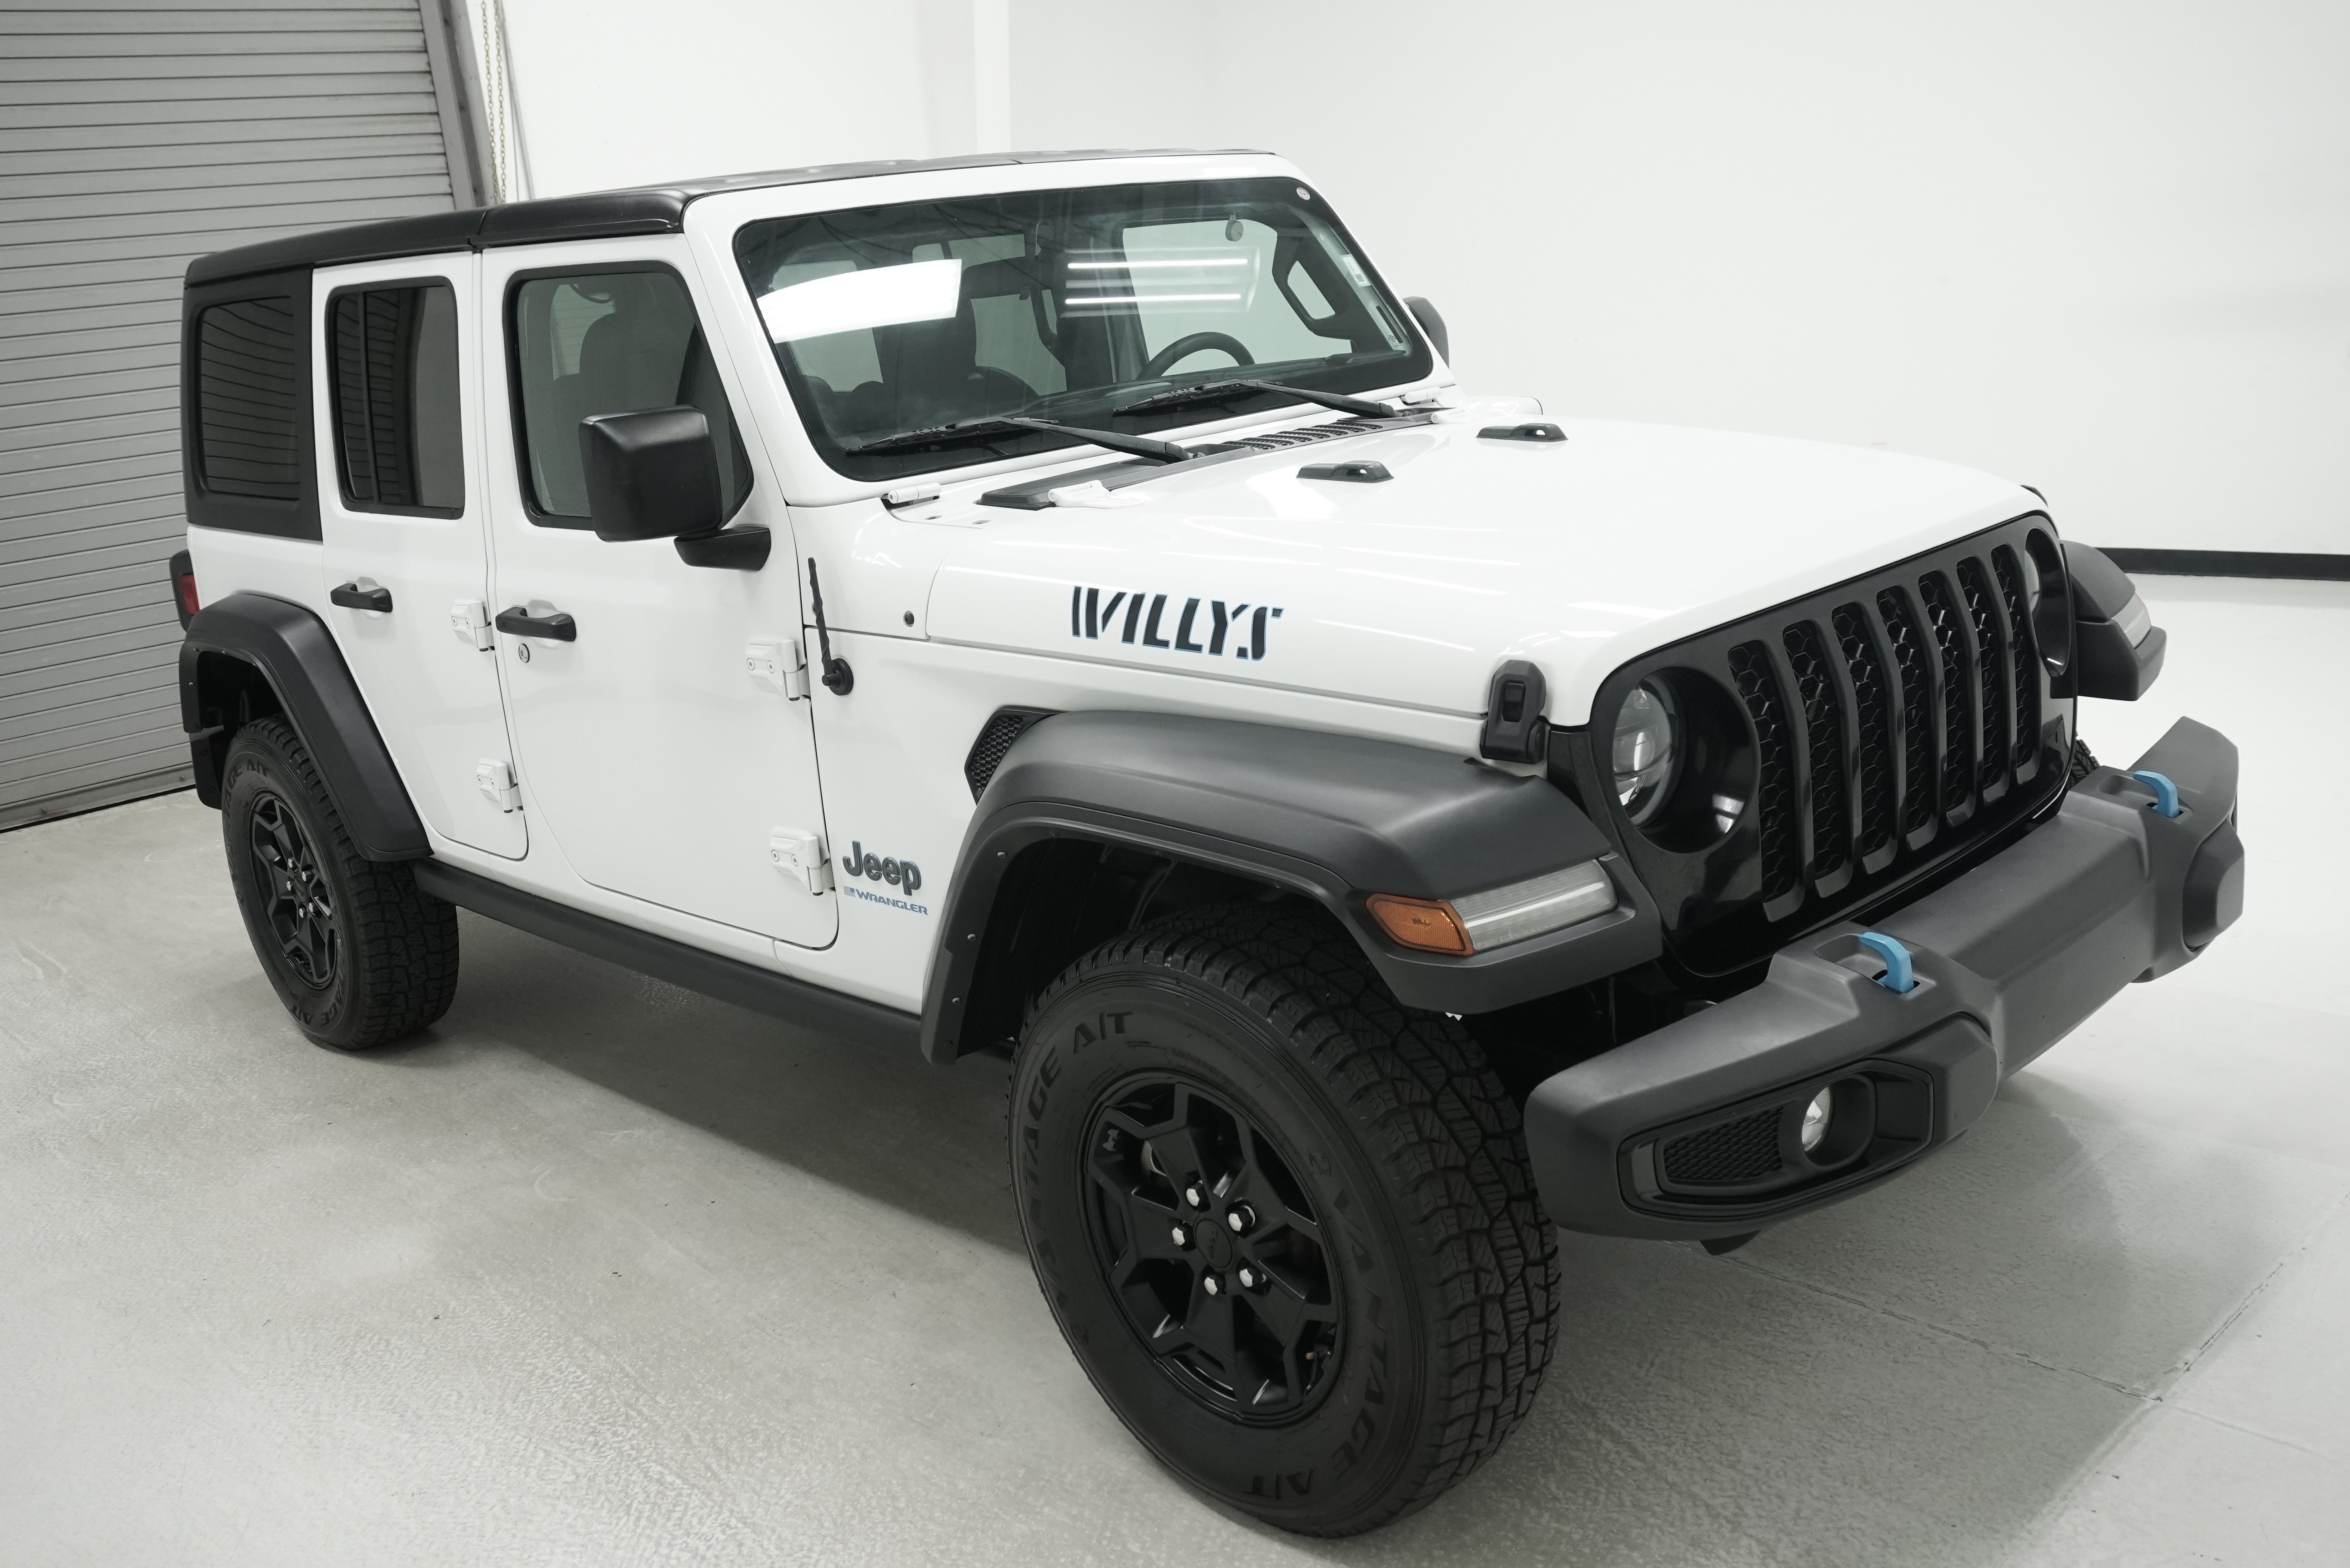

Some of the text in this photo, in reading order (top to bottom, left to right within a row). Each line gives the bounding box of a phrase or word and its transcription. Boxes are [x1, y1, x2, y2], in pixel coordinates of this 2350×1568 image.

[1072, 585, 1284, 661] WILLYS
[842, 840, 922, 896] Jeep
[855, 889, 929, 915] WRANGLER
